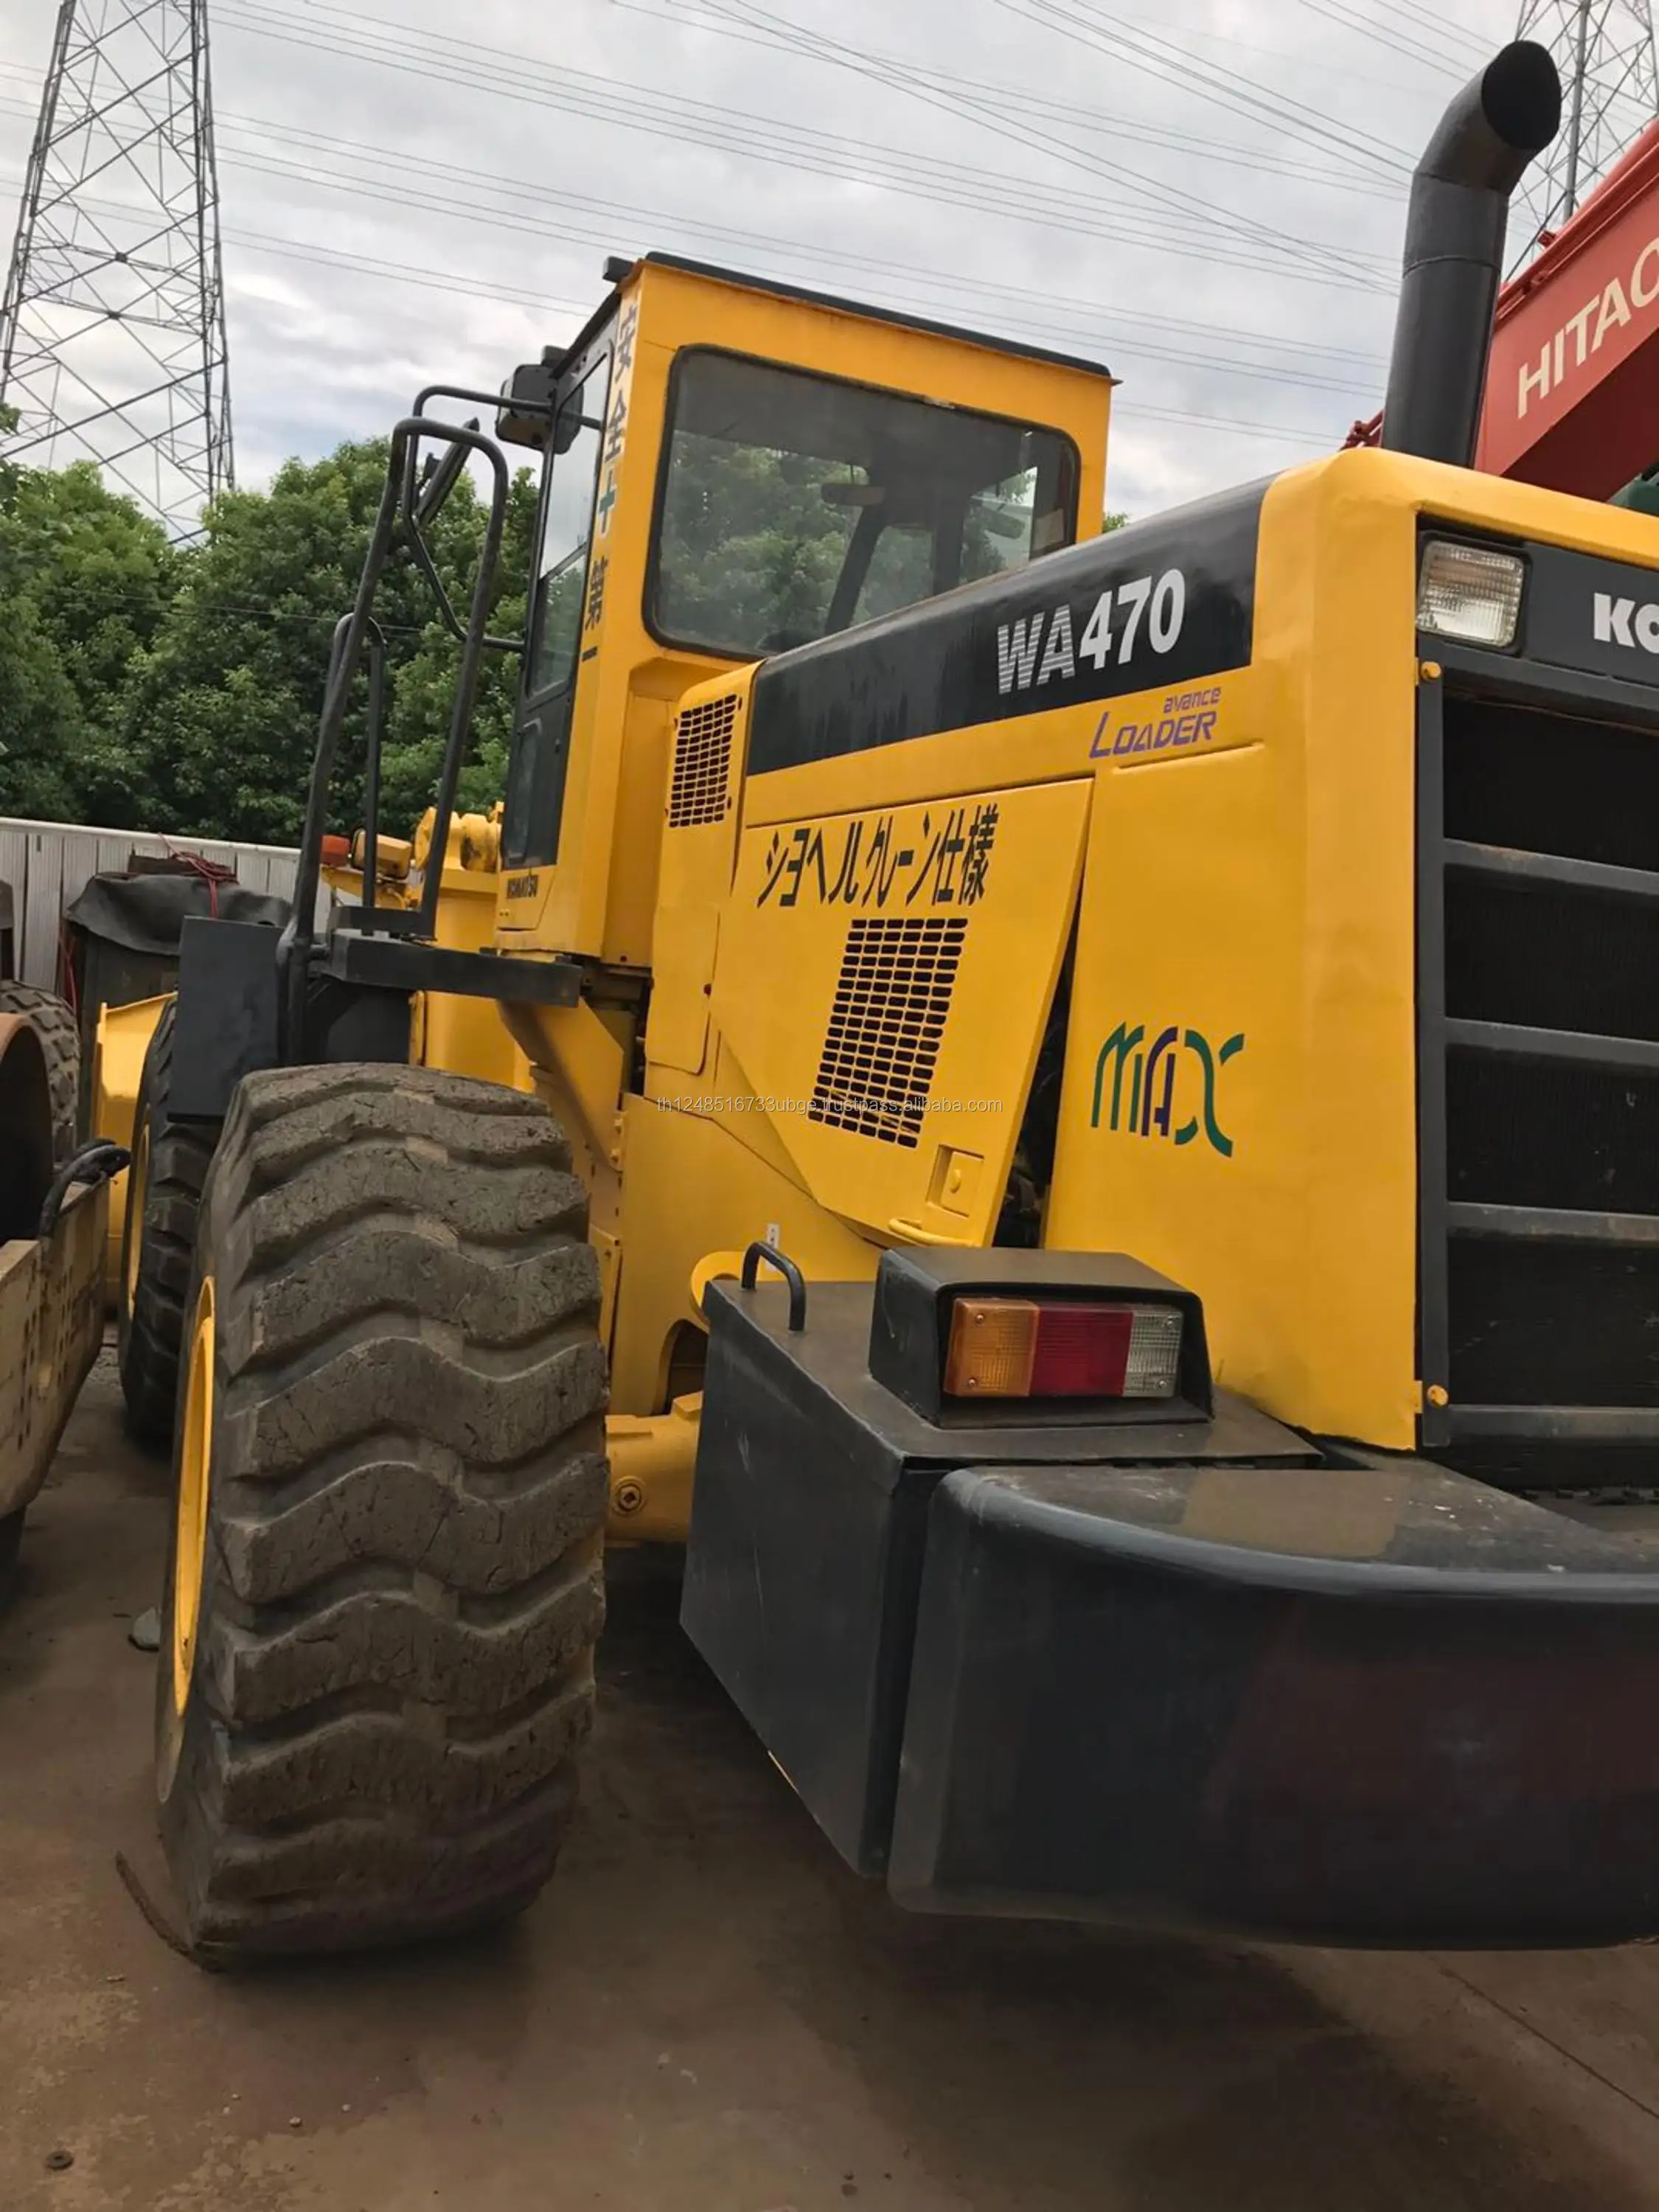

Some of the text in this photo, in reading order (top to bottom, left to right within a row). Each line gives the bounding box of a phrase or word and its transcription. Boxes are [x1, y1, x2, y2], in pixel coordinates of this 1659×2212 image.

[997, 568, 1186, 695] WA470
[1163, 686, 1222, 714] avance
[1088, 711, 1217, 759] LOADER
